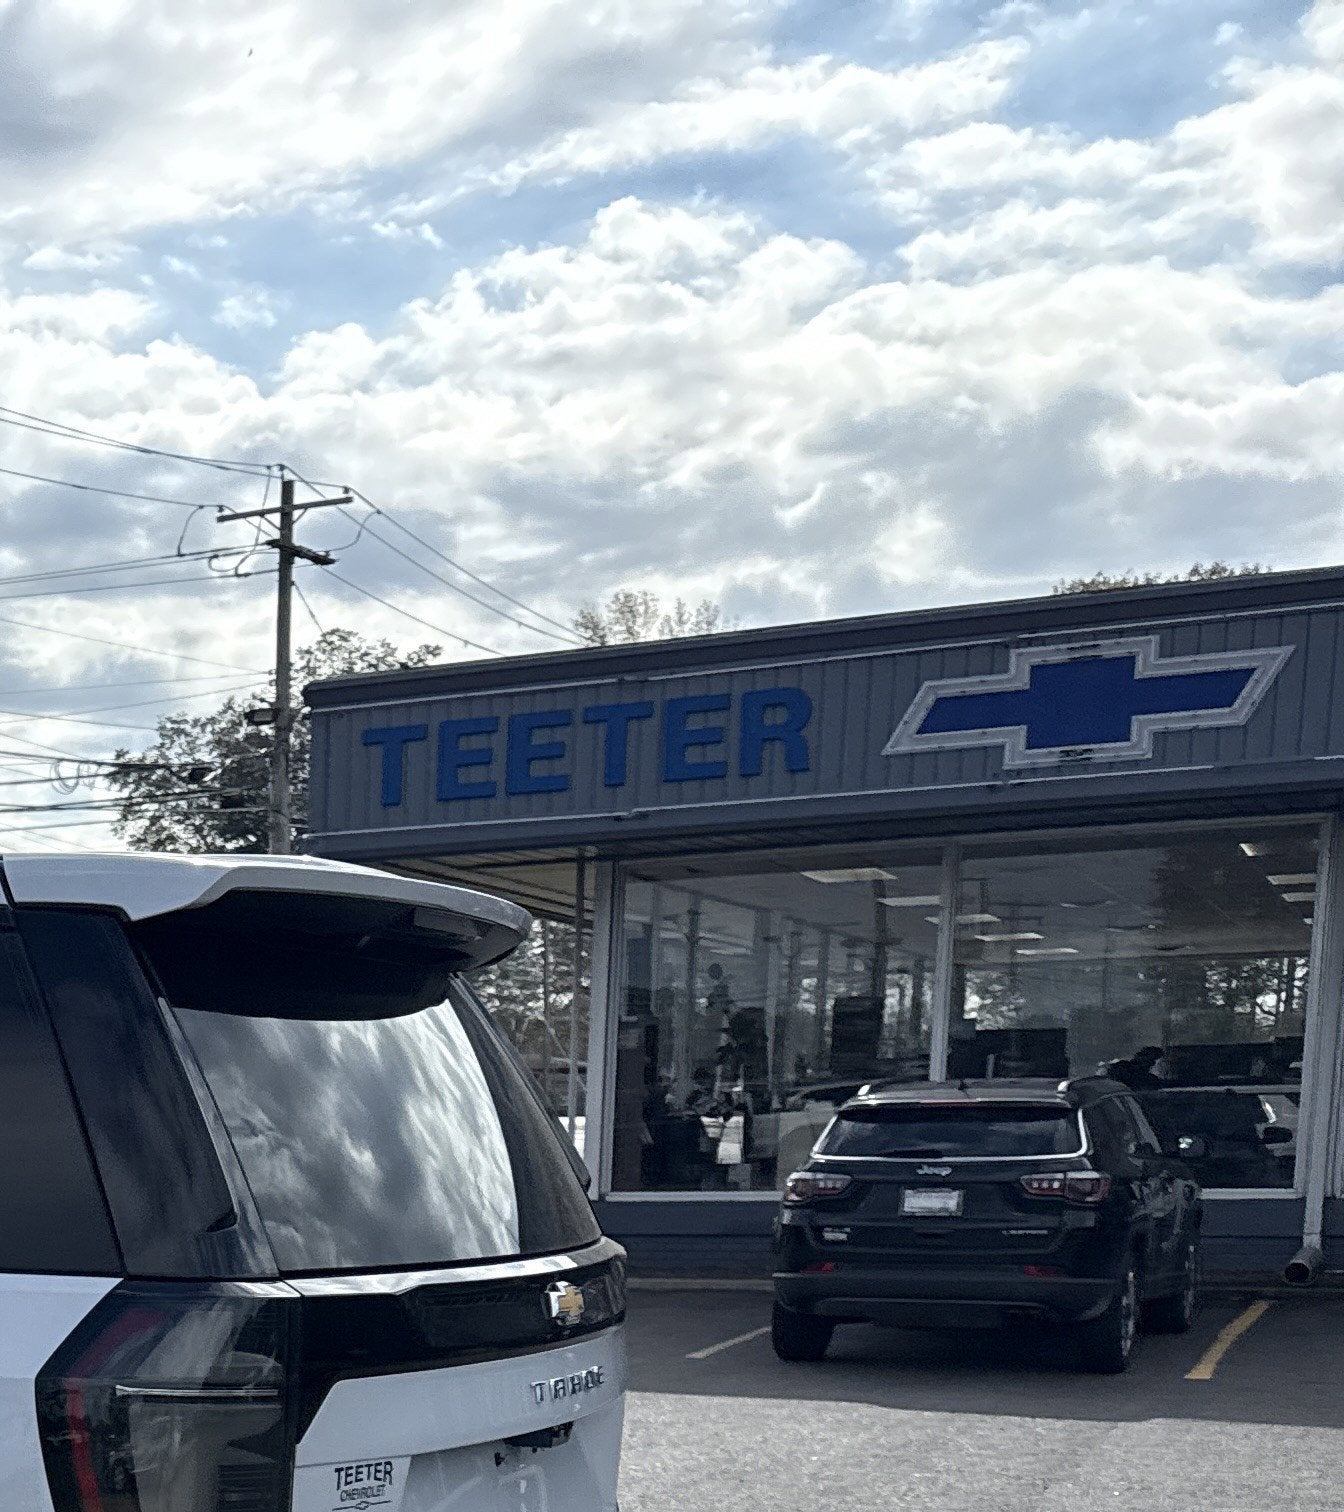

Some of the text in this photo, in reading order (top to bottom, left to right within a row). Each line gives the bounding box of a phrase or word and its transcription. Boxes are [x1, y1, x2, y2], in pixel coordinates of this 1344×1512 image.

[362, 686, 812, 808] TEETER
[530, 1366, 604, 1403] TAHOE
[334, 1461, 394, 1491] TEETER
